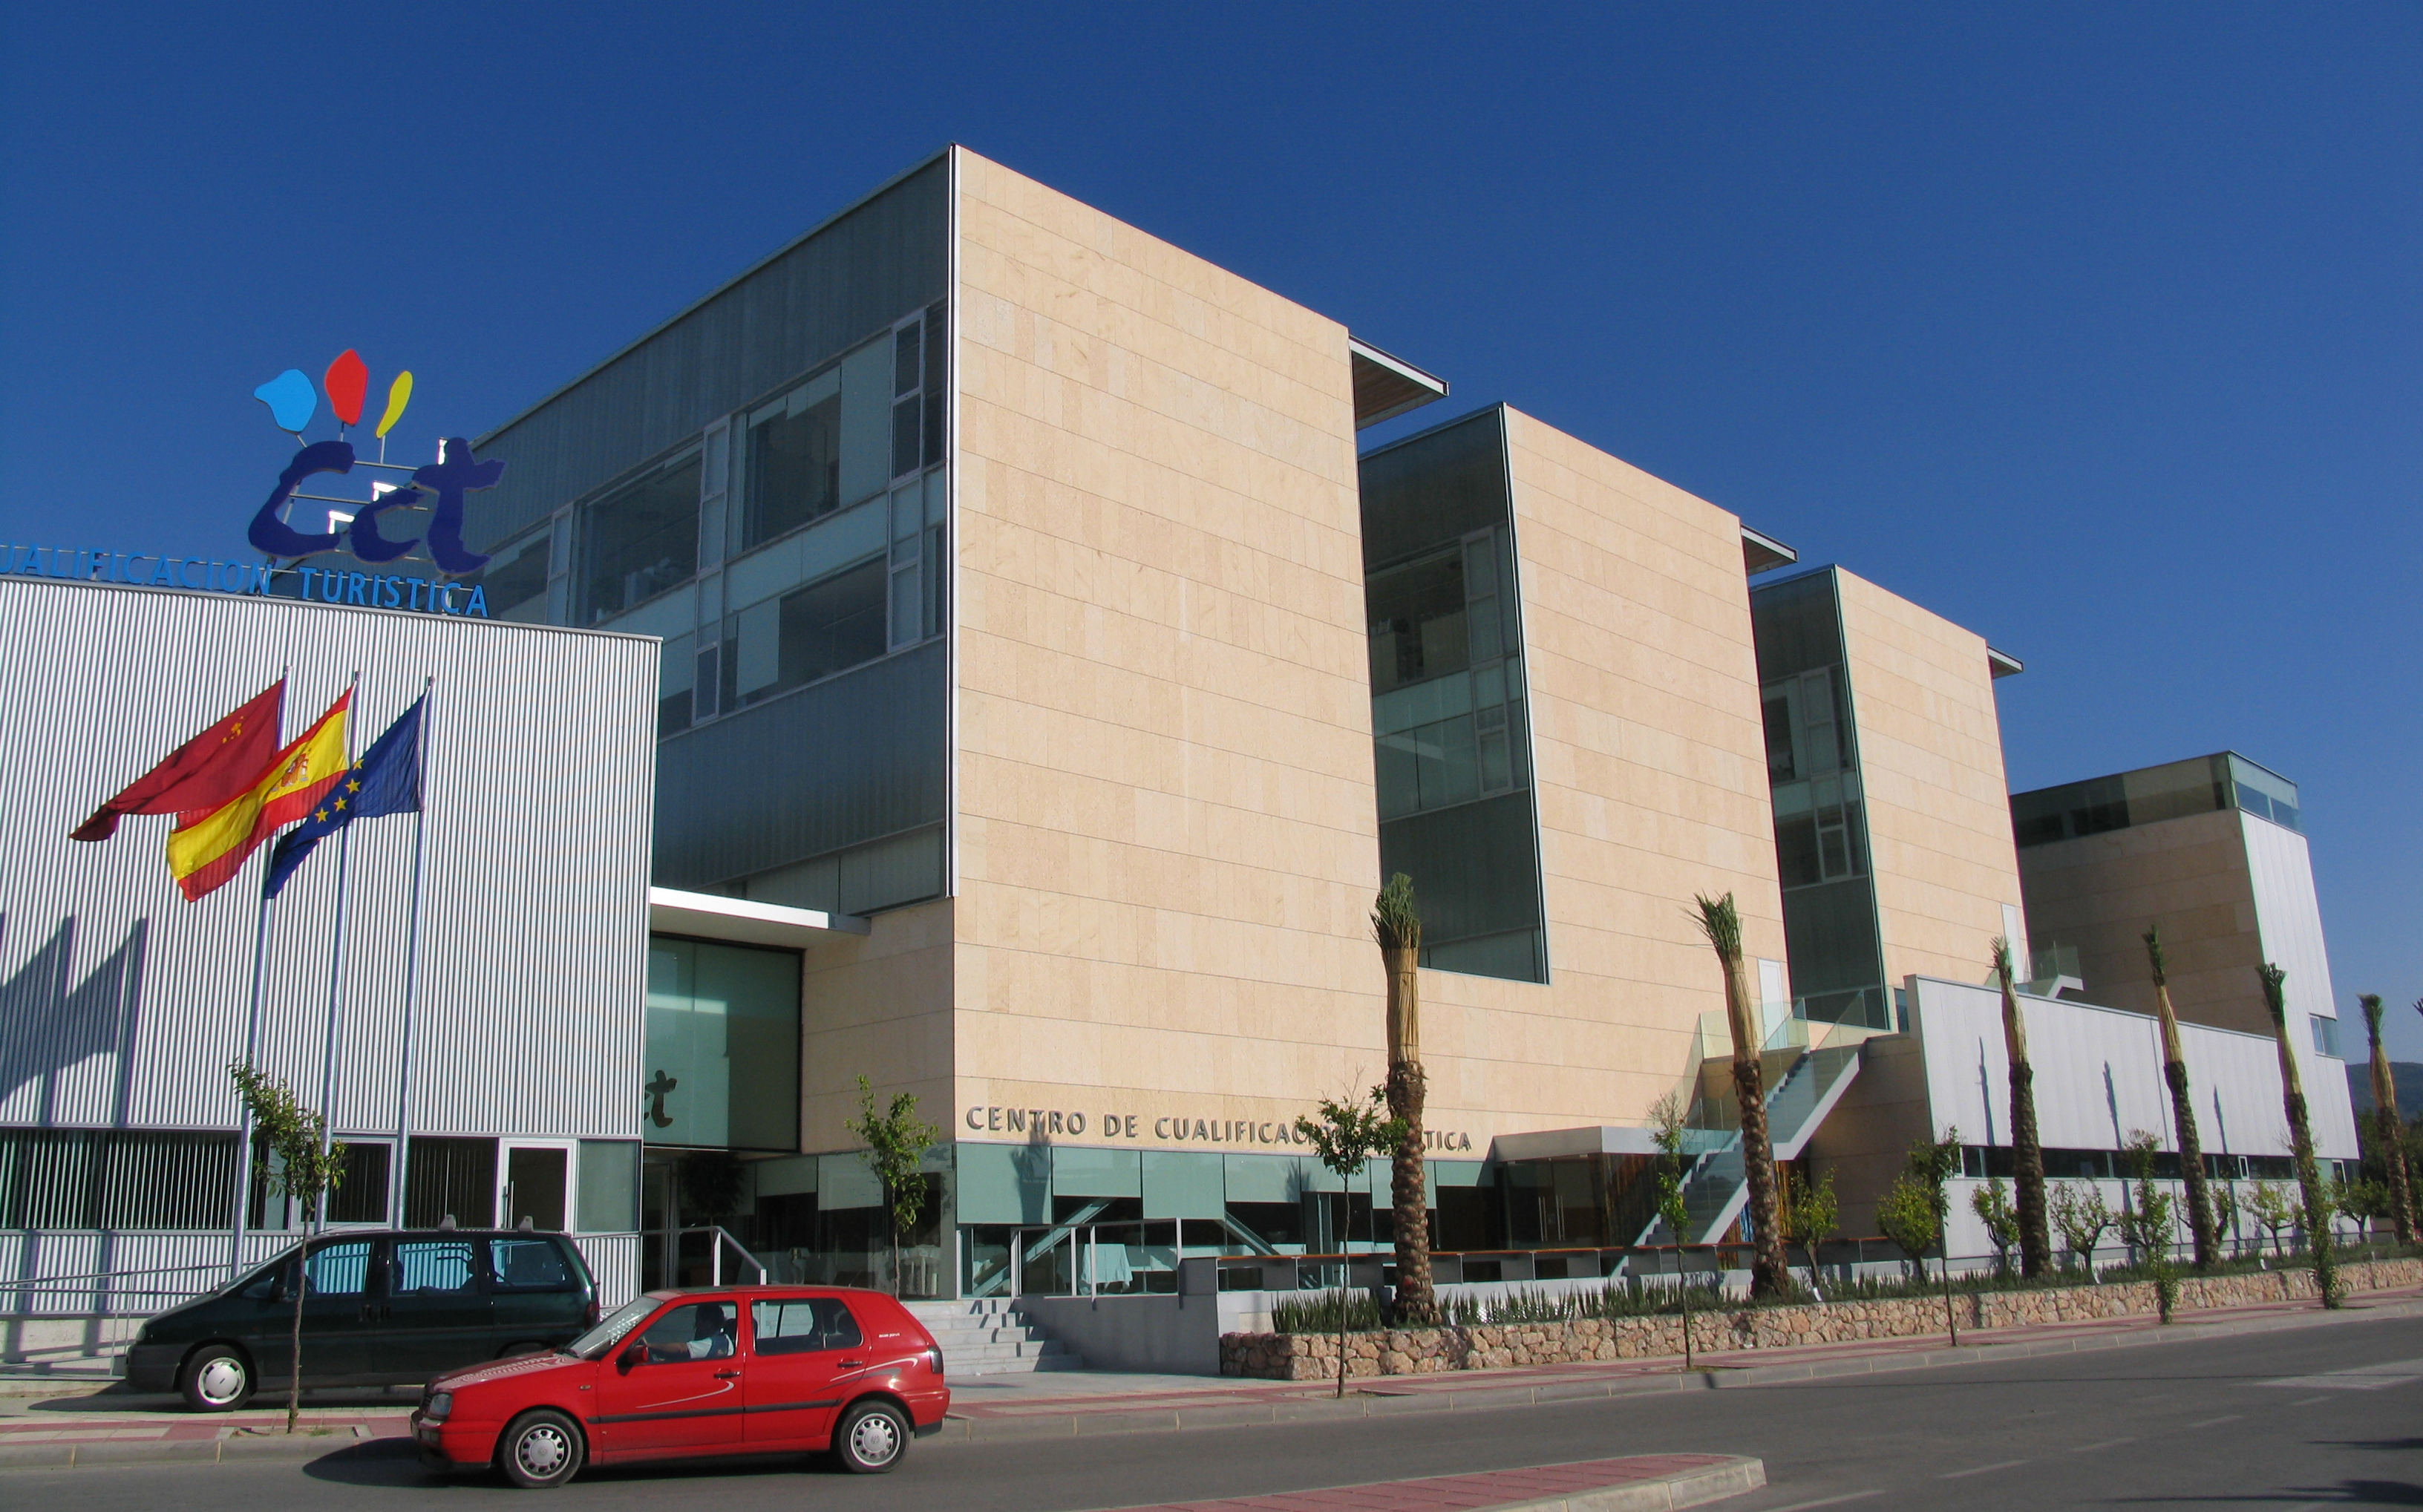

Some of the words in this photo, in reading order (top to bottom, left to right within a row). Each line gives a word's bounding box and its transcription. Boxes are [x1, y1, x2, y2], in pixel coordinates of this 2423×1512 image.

[298, 566, 489, 618] TURISTICA
[966, 1105, 1086, 1135] CENTRO
[1104, 1114, 1139, 1137] DE
[1155, 1116, 1342, 1147] CUALIFICAC
